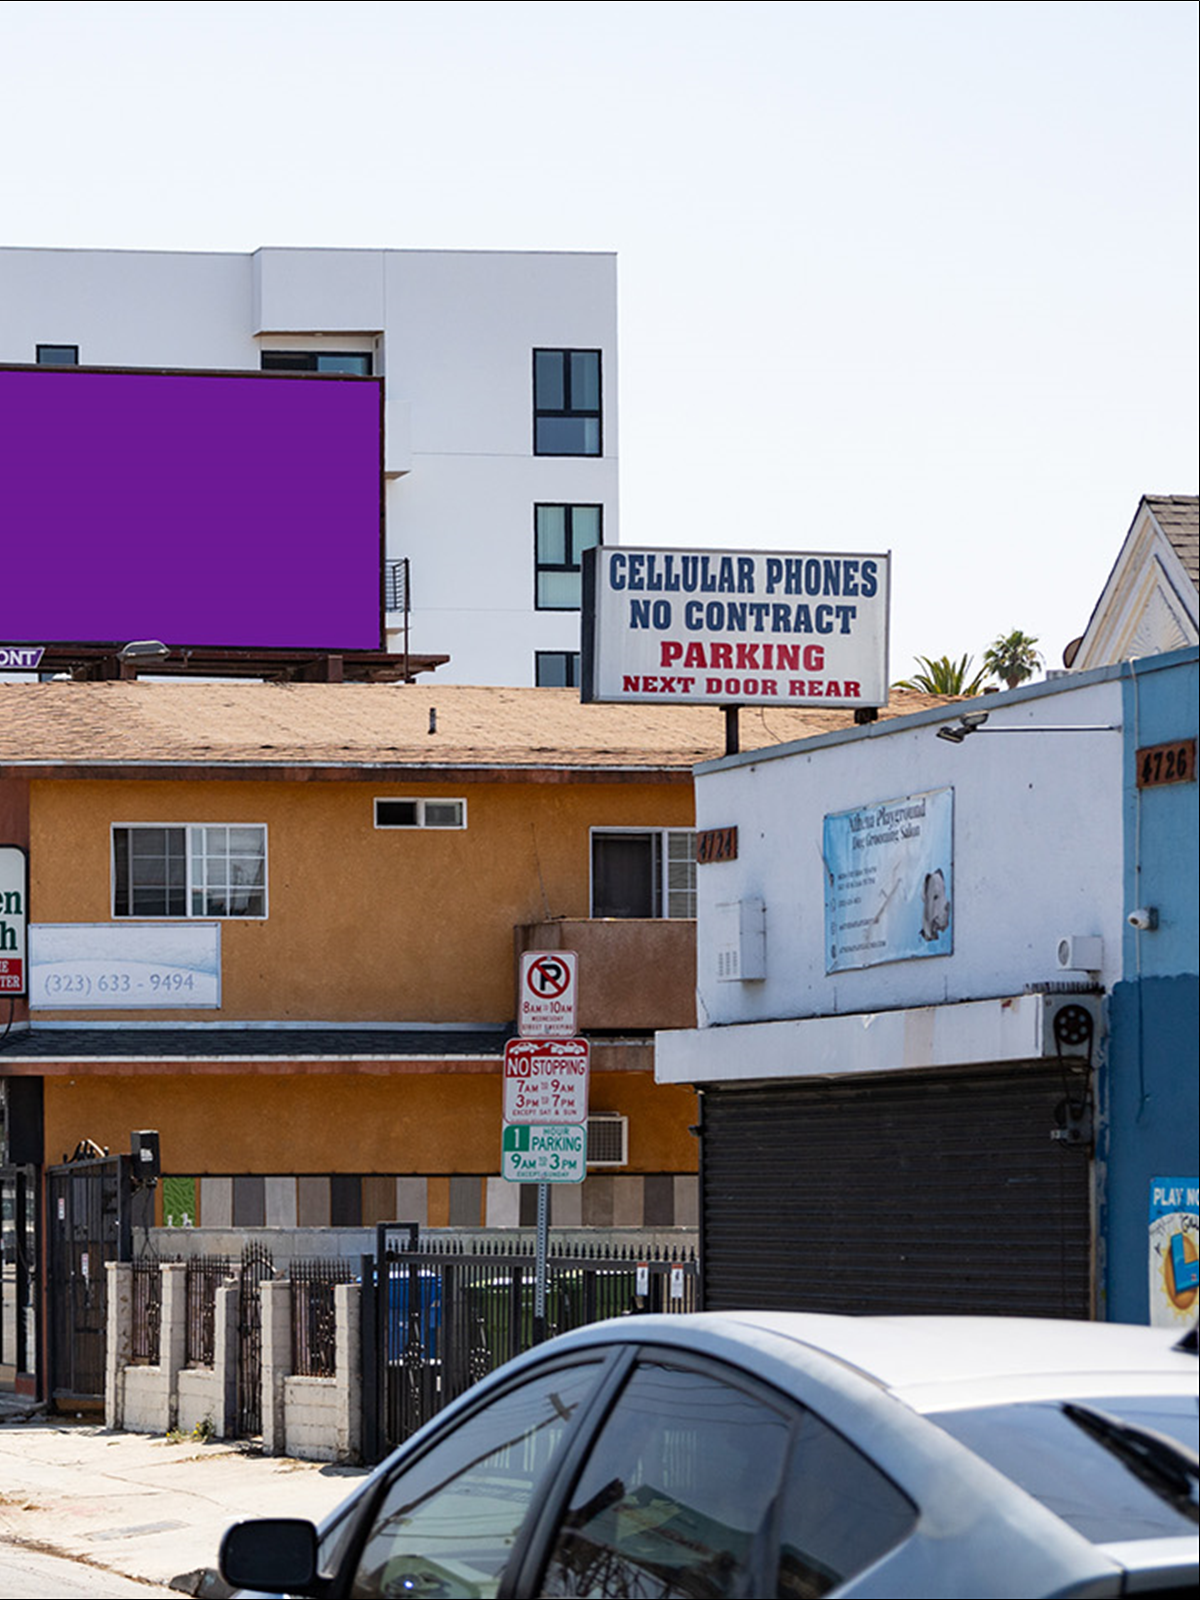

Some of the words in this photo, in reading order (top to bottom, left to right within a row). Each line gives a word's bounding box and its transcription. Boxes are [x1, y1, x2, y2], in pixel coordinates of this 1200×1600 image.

[609, 552, 756, 594] CELLULAR
[765, 557, 879, 598] PHONES
[629, 598, 673, 631] NO
[684, 600, 858, 635] CONTRACT
[659, 640, 826, 673] PARKING
[622, 675, 696, 694] NEXT
[705, 677, 779, 697] DOOR
[787, 680, 862, 698] REAR
[1141, 747, 1187, 784] 4726
[699, 830, 732, 860] 4724
[44, 973, 92, 997] (323)
[97, 974, 131, 992] 633
[149, 973, 195, 991] 9494
[523, 1001, 542, 1014] 8AM
[550, 1001, 573, 1014] 10AM
[507, 1057, 529, 1076] NO
[532, 1058, 586, 1076] STOPPING
[516, 1079, 539, 1093] 7AM
[550, 1078, 575, 1093] 9AM
[515, 1094, 539, 1108] 3PM
[551, 1094, 575, 1107] 7PM
[513, 1127, 520, 1149] 1
[543, 1127, 570, 1136] HOUR
[531, 1136, 583, 1152] PARKING
[510, 1153, 537, 1170] 9AM
[549, 1153, 578, 1170] 3PM
[1153, 1187, 1184, 1206] PLAY
[1186, 1187, 1199, 1206] N
